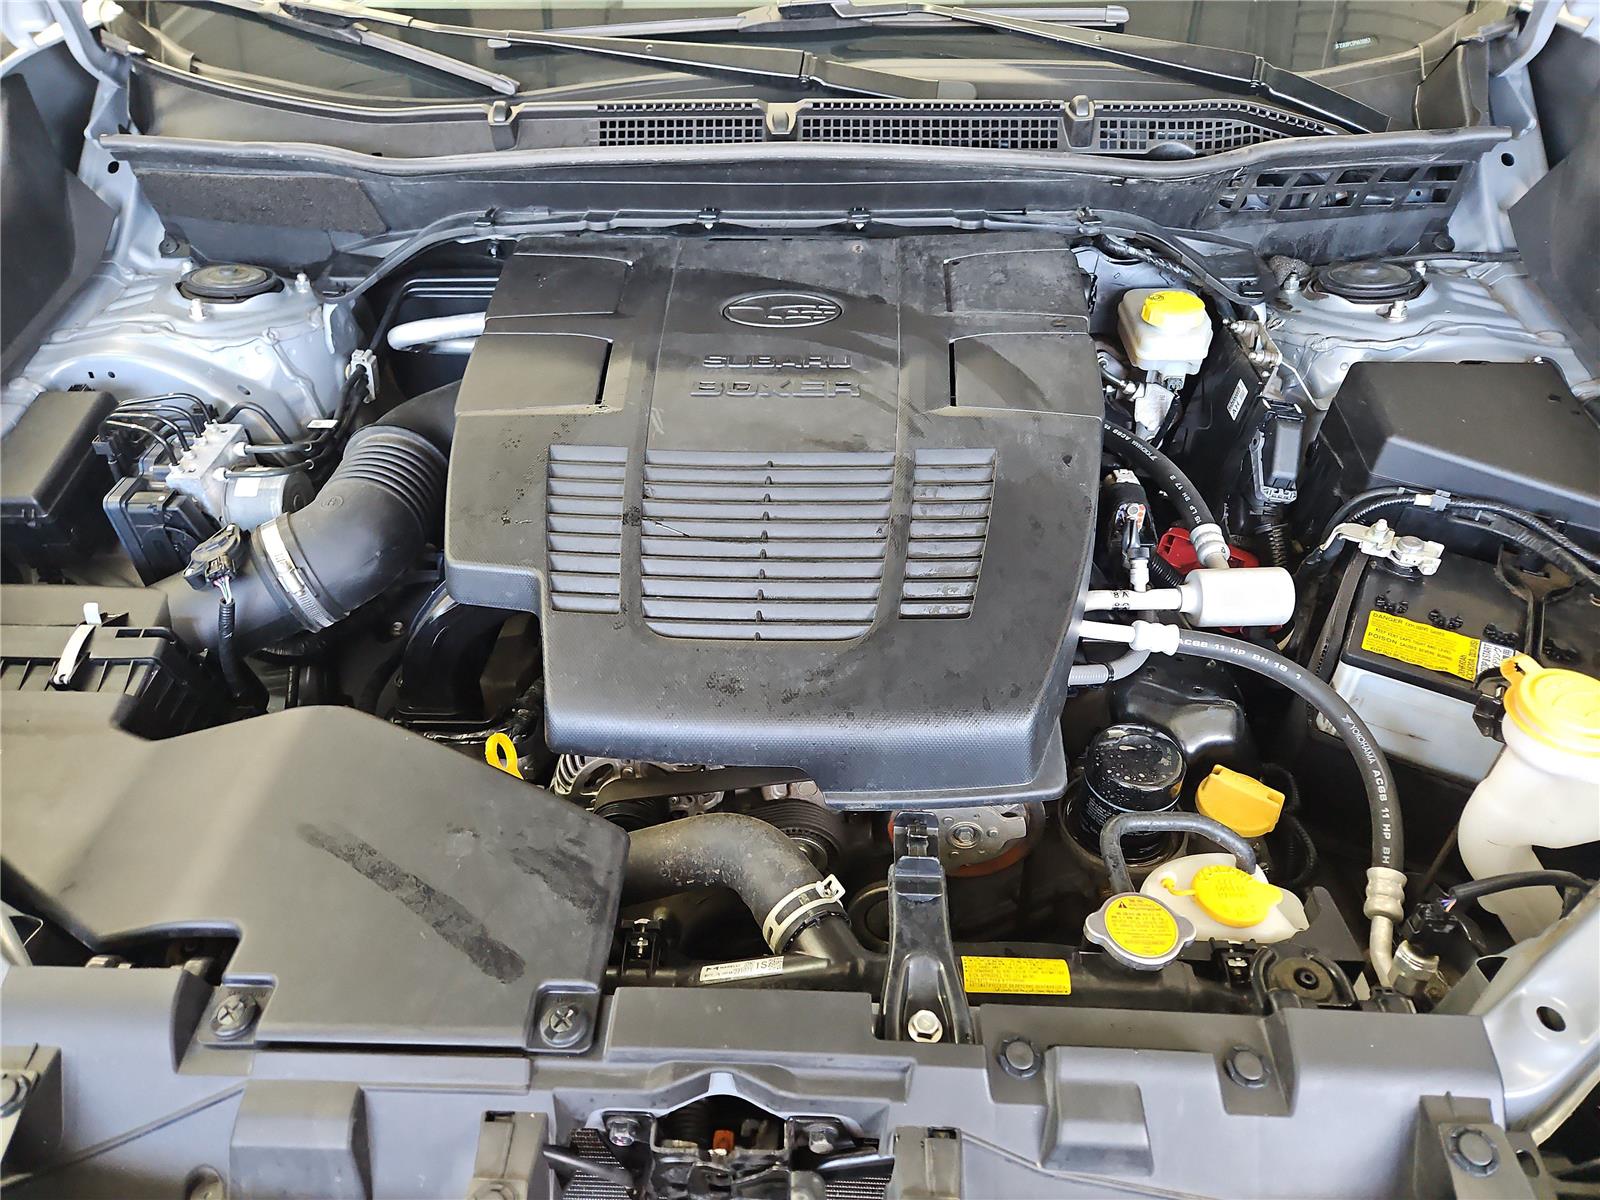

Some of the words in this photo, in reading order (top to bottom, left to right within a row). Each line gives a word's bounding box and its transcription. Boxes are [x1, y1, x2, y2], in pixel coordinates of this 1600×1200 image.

[702, 355, 852, 368] SUBARU
[690, 380, 860, 398] BOXER
[1372, 612, 1403, 624] DANGER
[1367, 631, 1397, 644] POISON
[1230, 647, 1246, 656] HP
[1350, 724, 1376, 764] YOKOHAMA
[1381, 807, 1390, 818] 11
[1382, 824, 1391, 840] HP
[1382, 846, 1390, 864] BH
